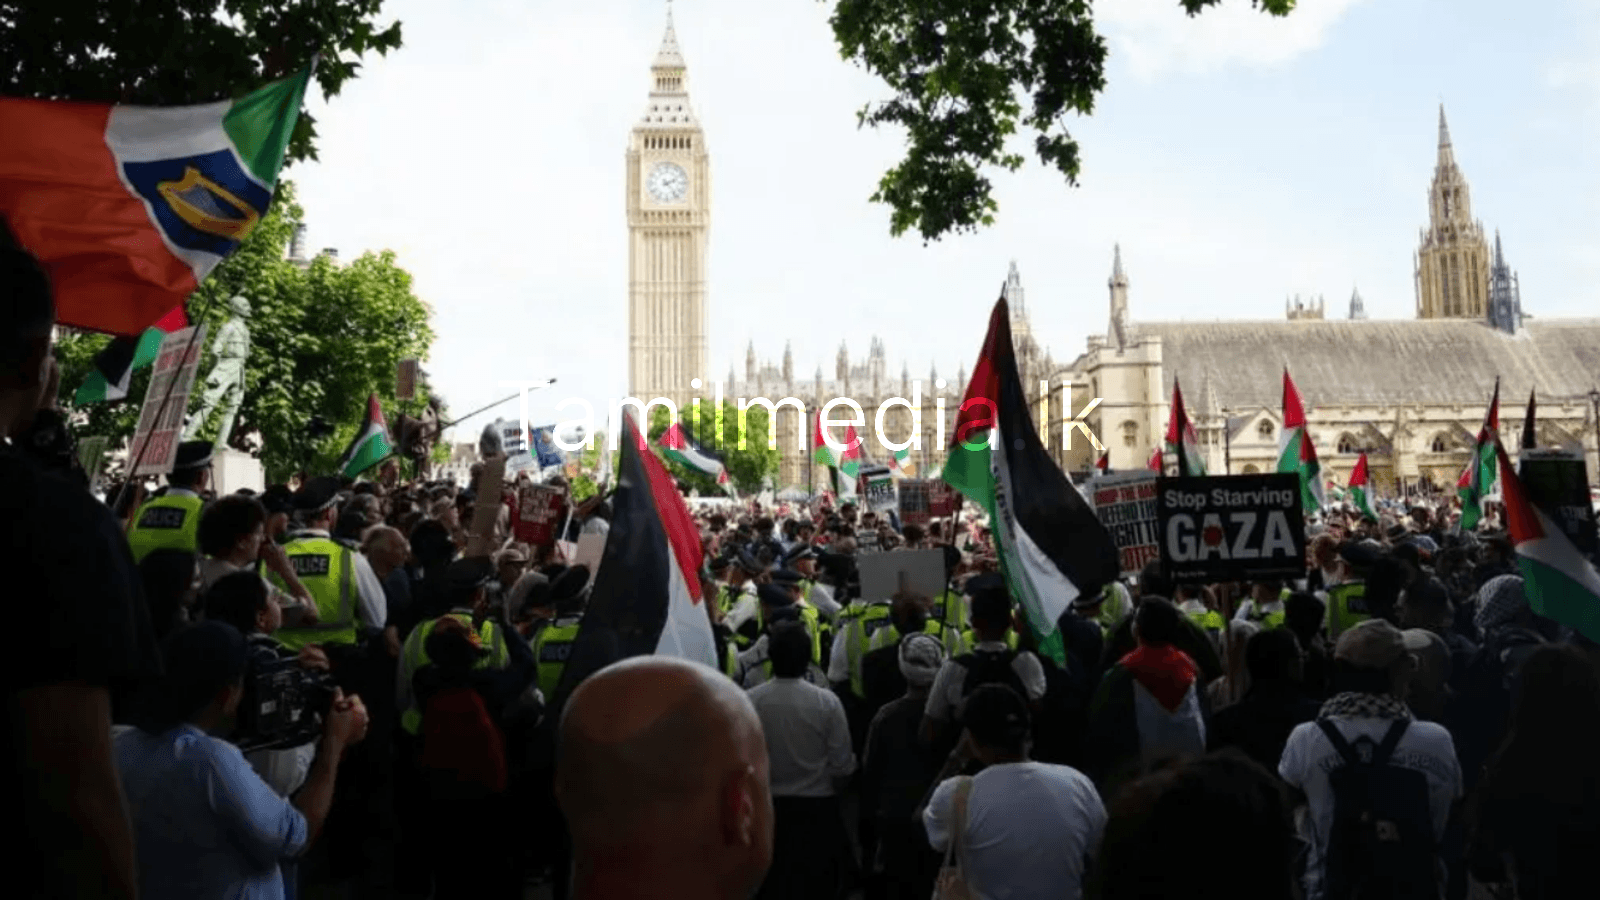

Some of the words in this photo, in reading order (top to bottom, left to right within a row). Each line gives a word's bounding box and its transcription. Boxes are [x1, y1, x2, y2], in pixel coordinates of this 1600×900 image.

[1164, 489, 1207, 511] Stop
[1211, 486, 1294, 508] Starving
[1166, 509, 1298, 563] GAZA
[292, 557, 327, 573] OLICE
